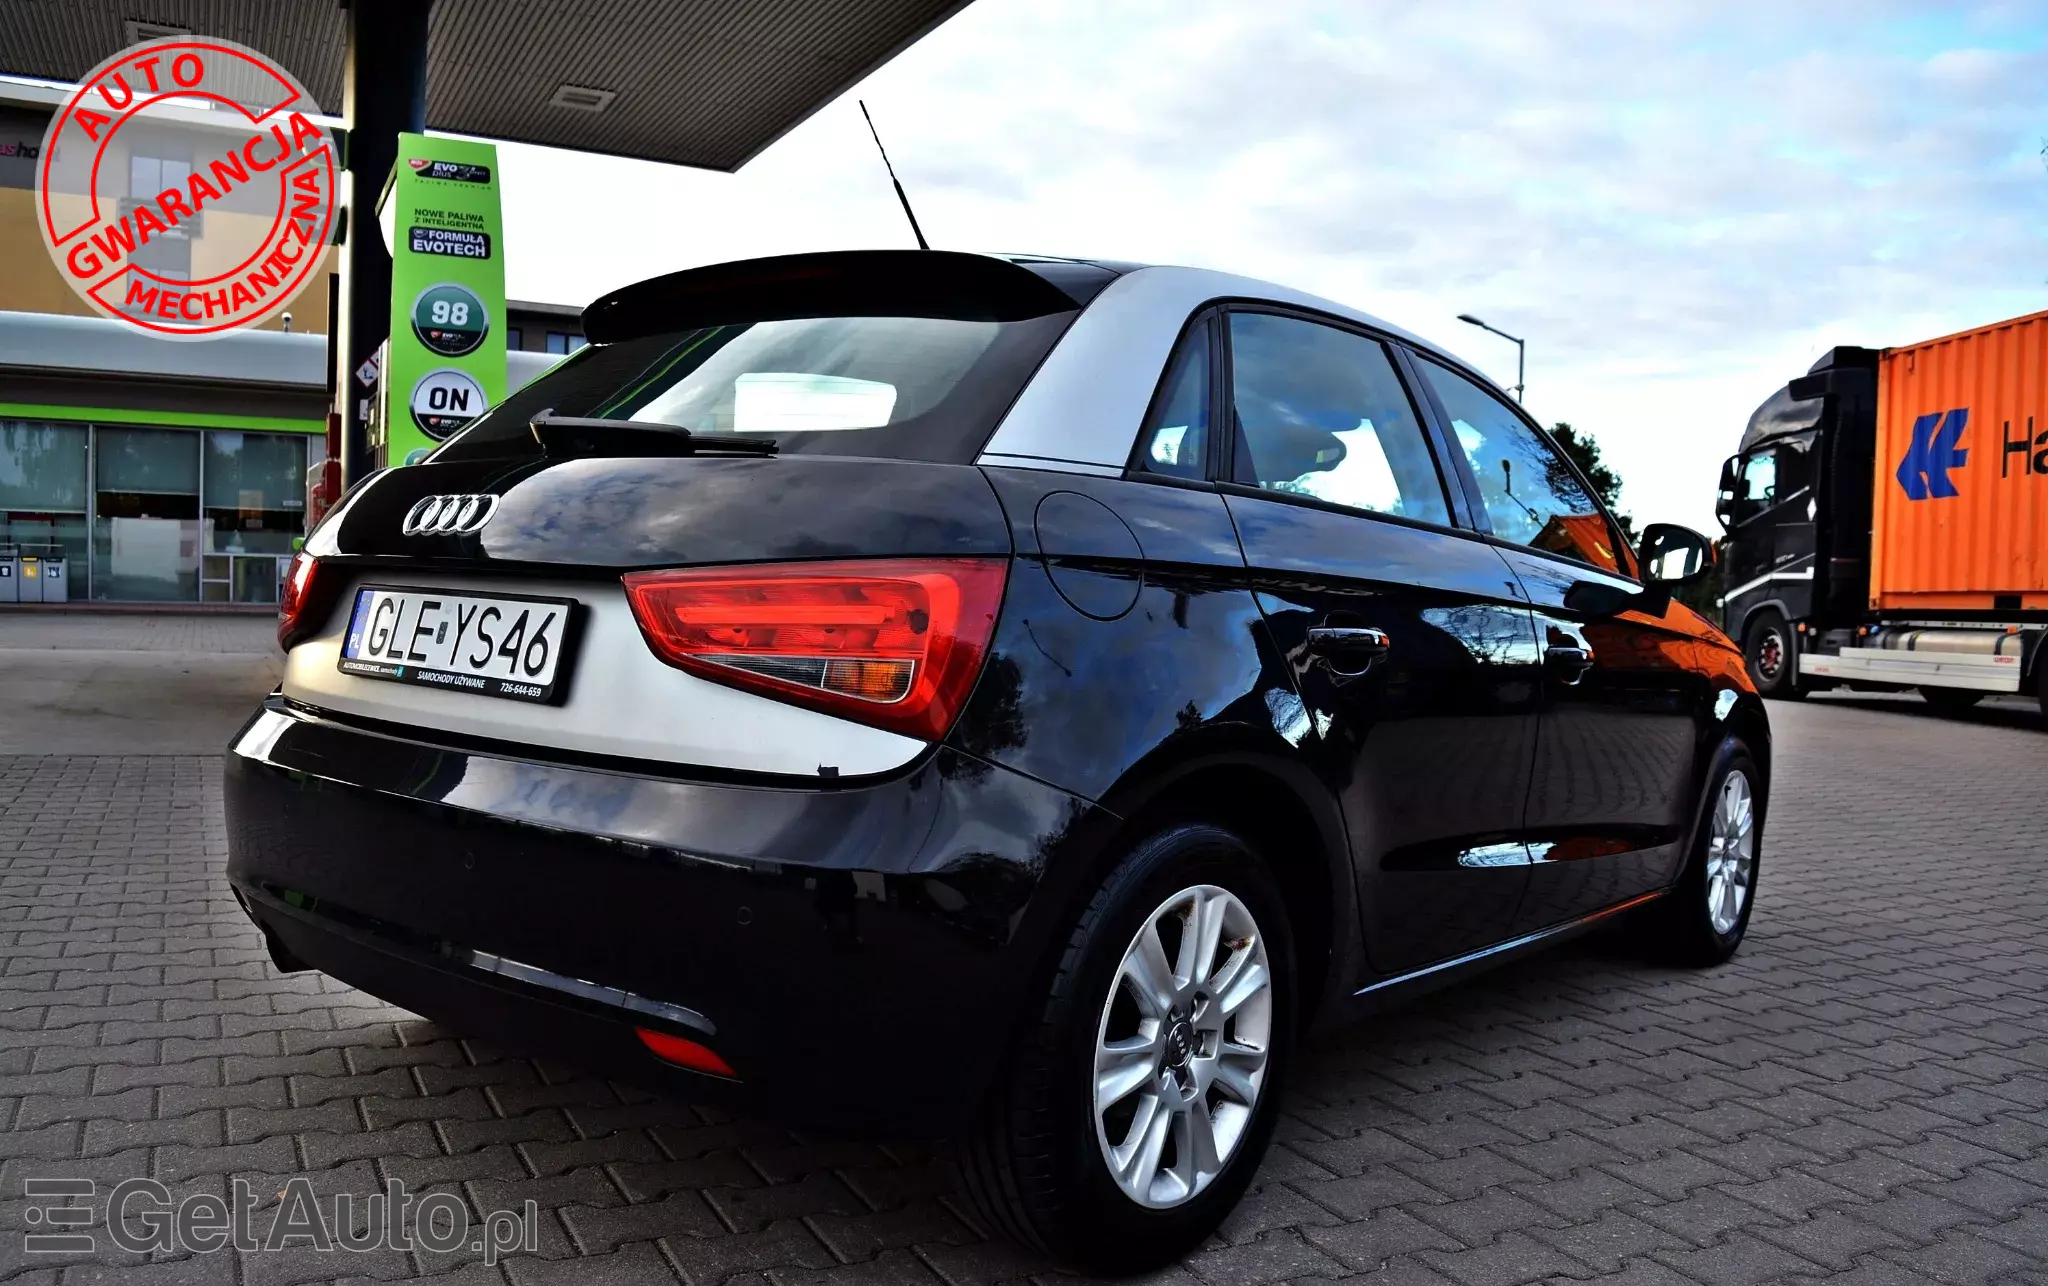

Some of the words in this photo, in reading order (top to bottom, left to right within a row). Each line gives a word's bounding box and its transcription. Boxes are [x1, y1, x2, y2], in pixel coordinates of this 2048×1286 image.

[432, 170, 452, 178] plus
[433, 162, 458, 172] EVO
[414, 208, 445, 219] NOWE
[447, 212, 485, 222] PALIWA
[413, 238, 486, 257] EVOTECH
[431, 300, 469, 326] 98
[428, 386, 470, 411] ON
[348, 632, 361, 650] PL
[368, 598, 441, 662] GLE
[449, 603, 557, 678] YS46
[416, 670, 454, 685] SAMOCHODY
[454, 673, 486, 689] UŻYWANE
[499, 682, 542, 697] 726-644-659
